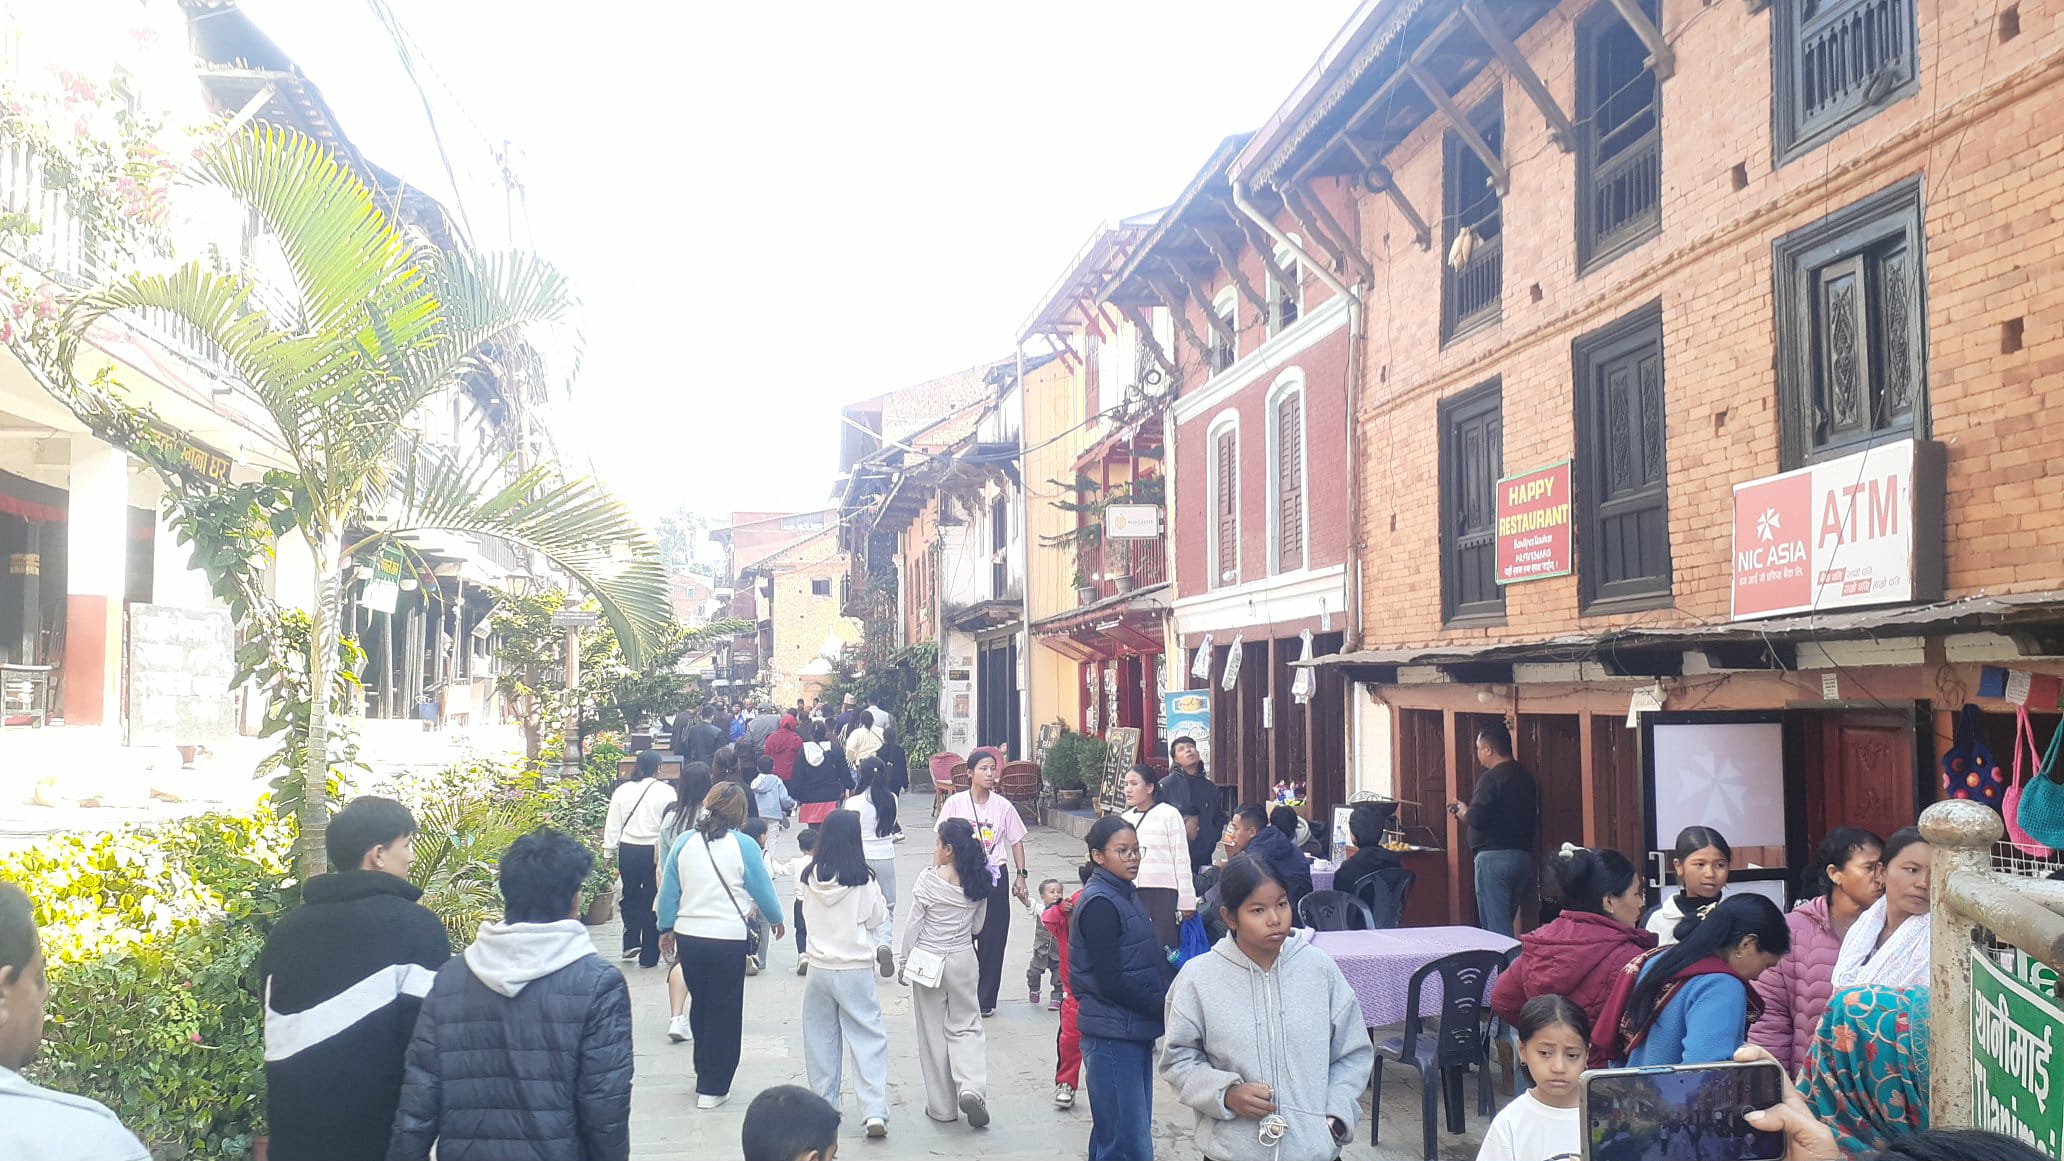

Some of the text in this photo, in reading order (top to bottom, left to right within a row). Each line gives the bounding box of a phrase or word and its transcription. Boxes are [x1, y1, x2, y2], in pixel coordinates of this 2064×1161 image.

[1508, 476, 1554, 506] HAPPY
[1818, 474, 1898, 549] ATM
[1499, 503, 1569, 537] RESTAURANT
[1738, 539, 1807, 572] NIC ASIA
[1976, 989, 2053, 1115] थानीमाई
[1974, 1057, 2055, 1158] Thani
